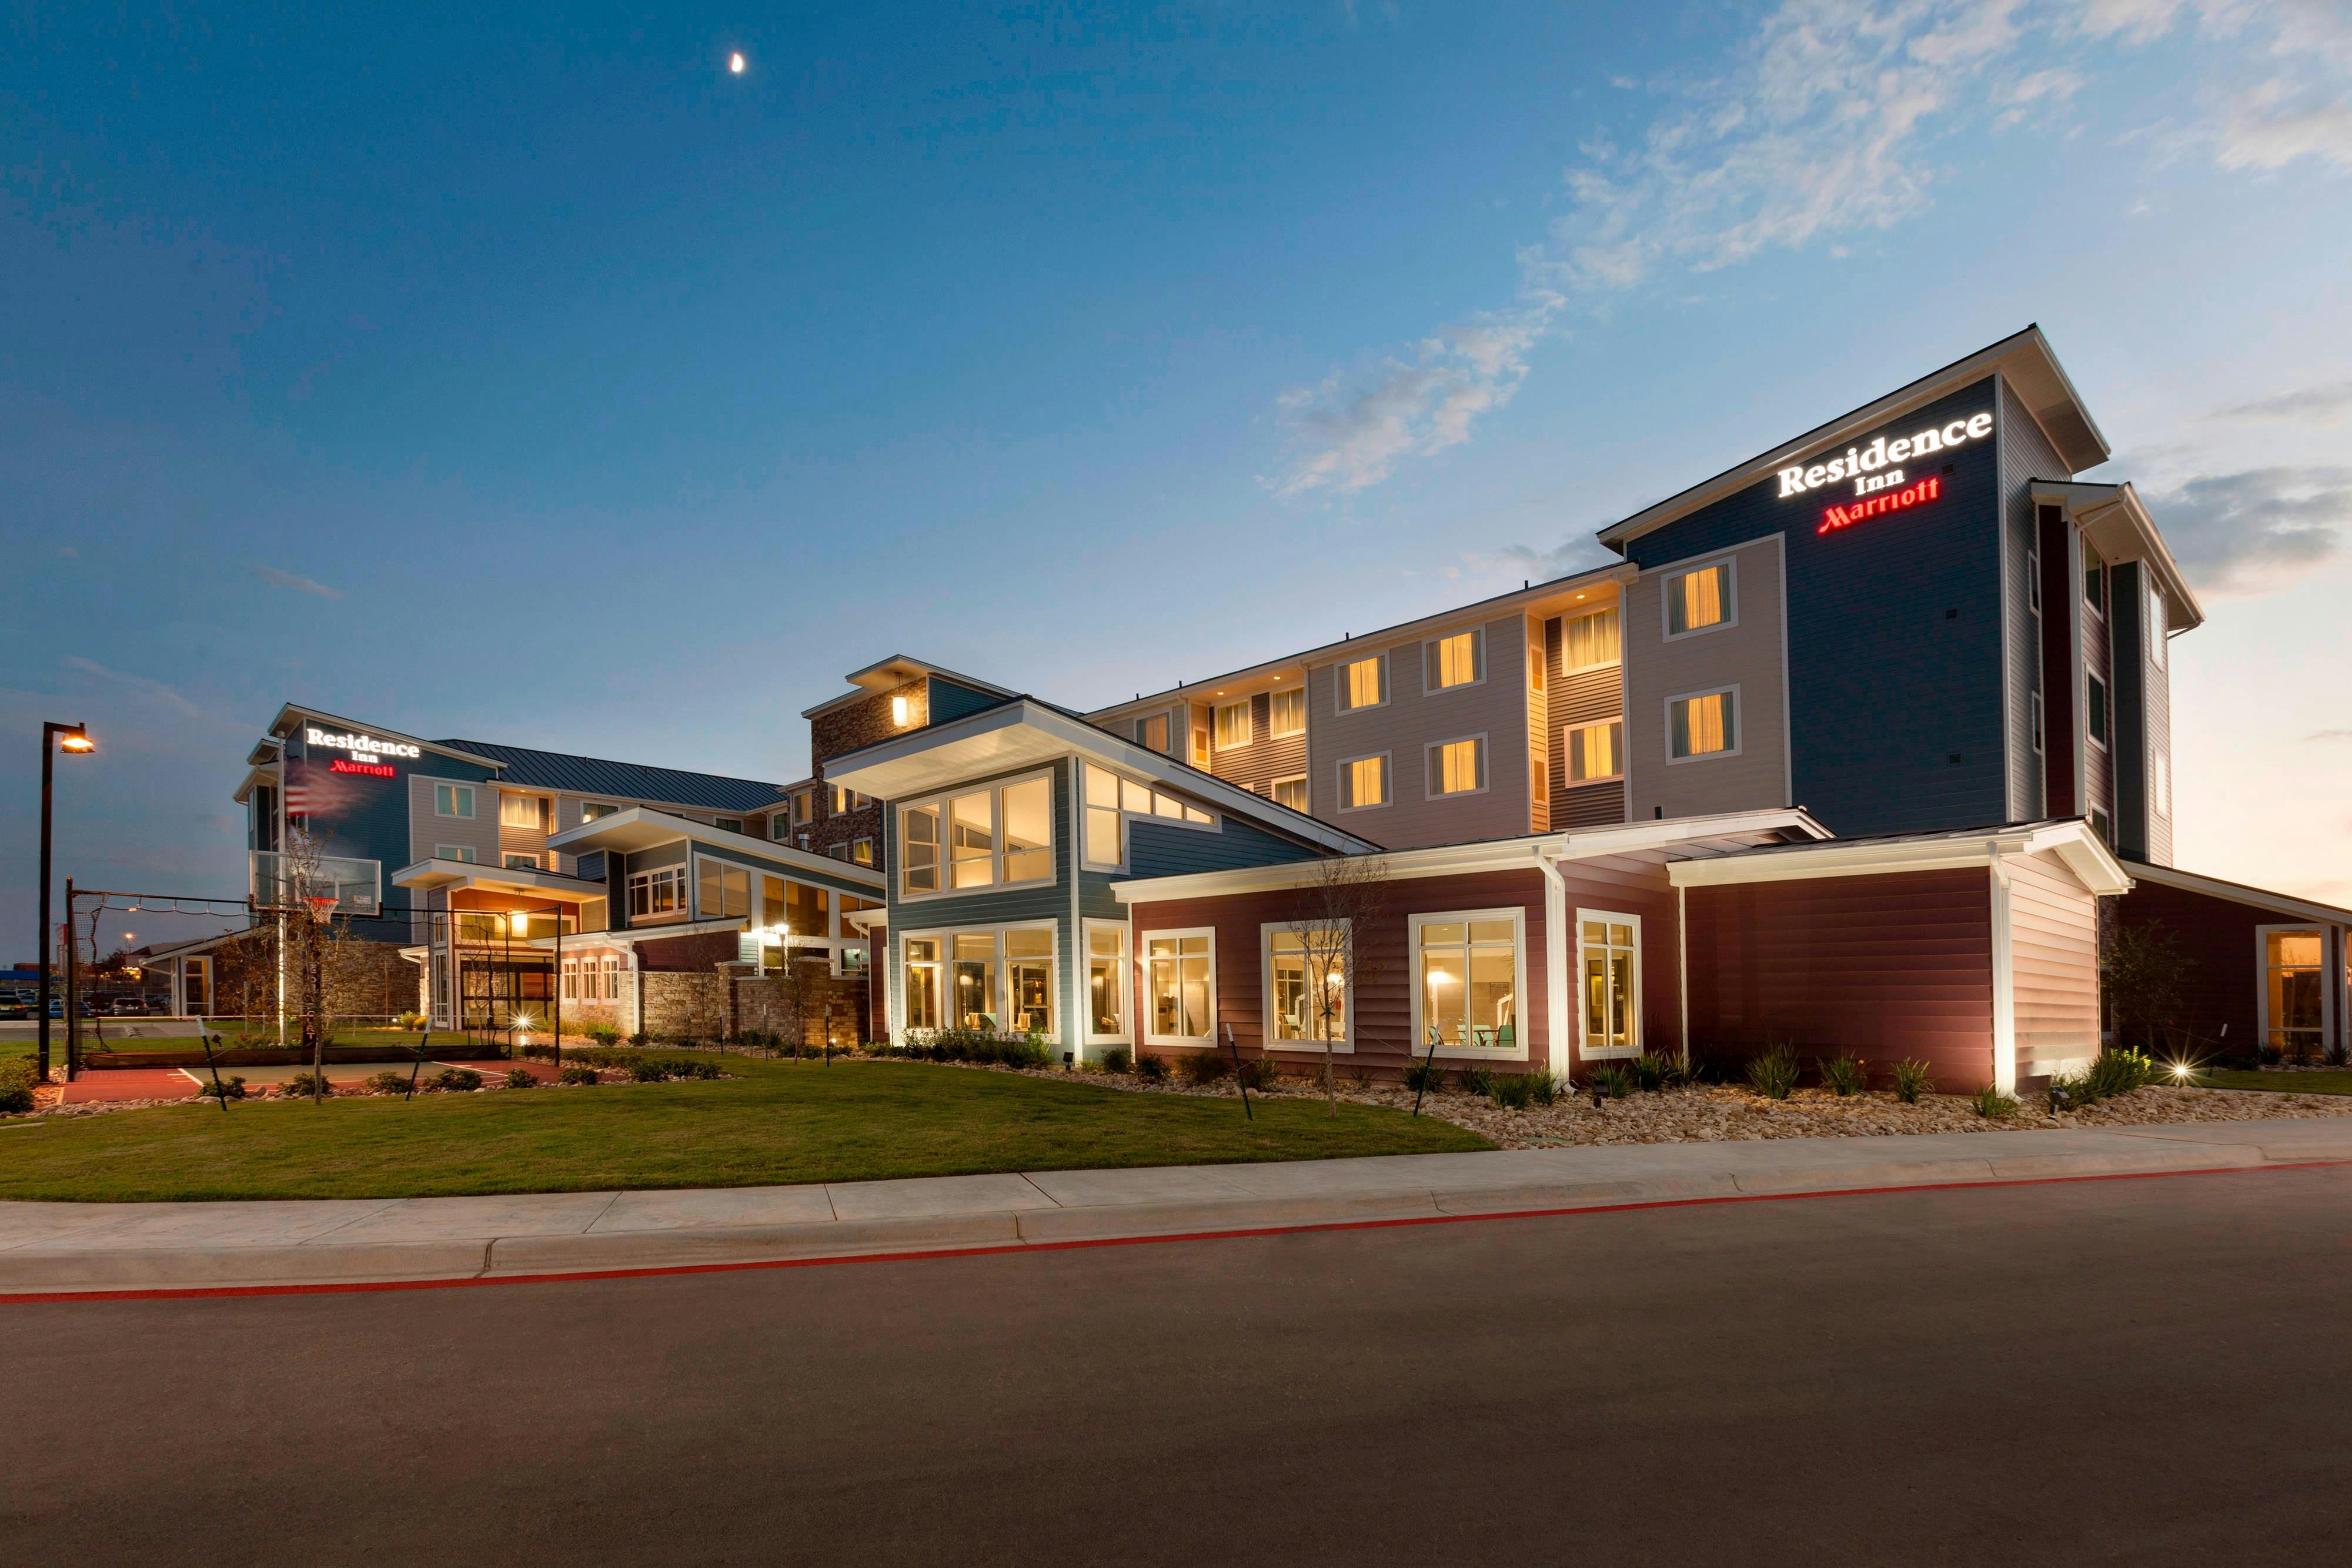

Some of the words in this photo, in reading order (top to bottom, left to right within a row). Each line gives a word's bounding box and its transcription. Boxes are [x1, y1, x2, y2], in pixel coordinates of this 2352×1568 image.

[1778, 412, 1993, 499] Residence
[1855, 469, 1905, 496] Inn
[1818, 477, 1939, 533] Marriott
[306, 728, 420, 758] Residence
[351, 750, 378, 764] Inn
[330, 759, 395, 777] Marriott
